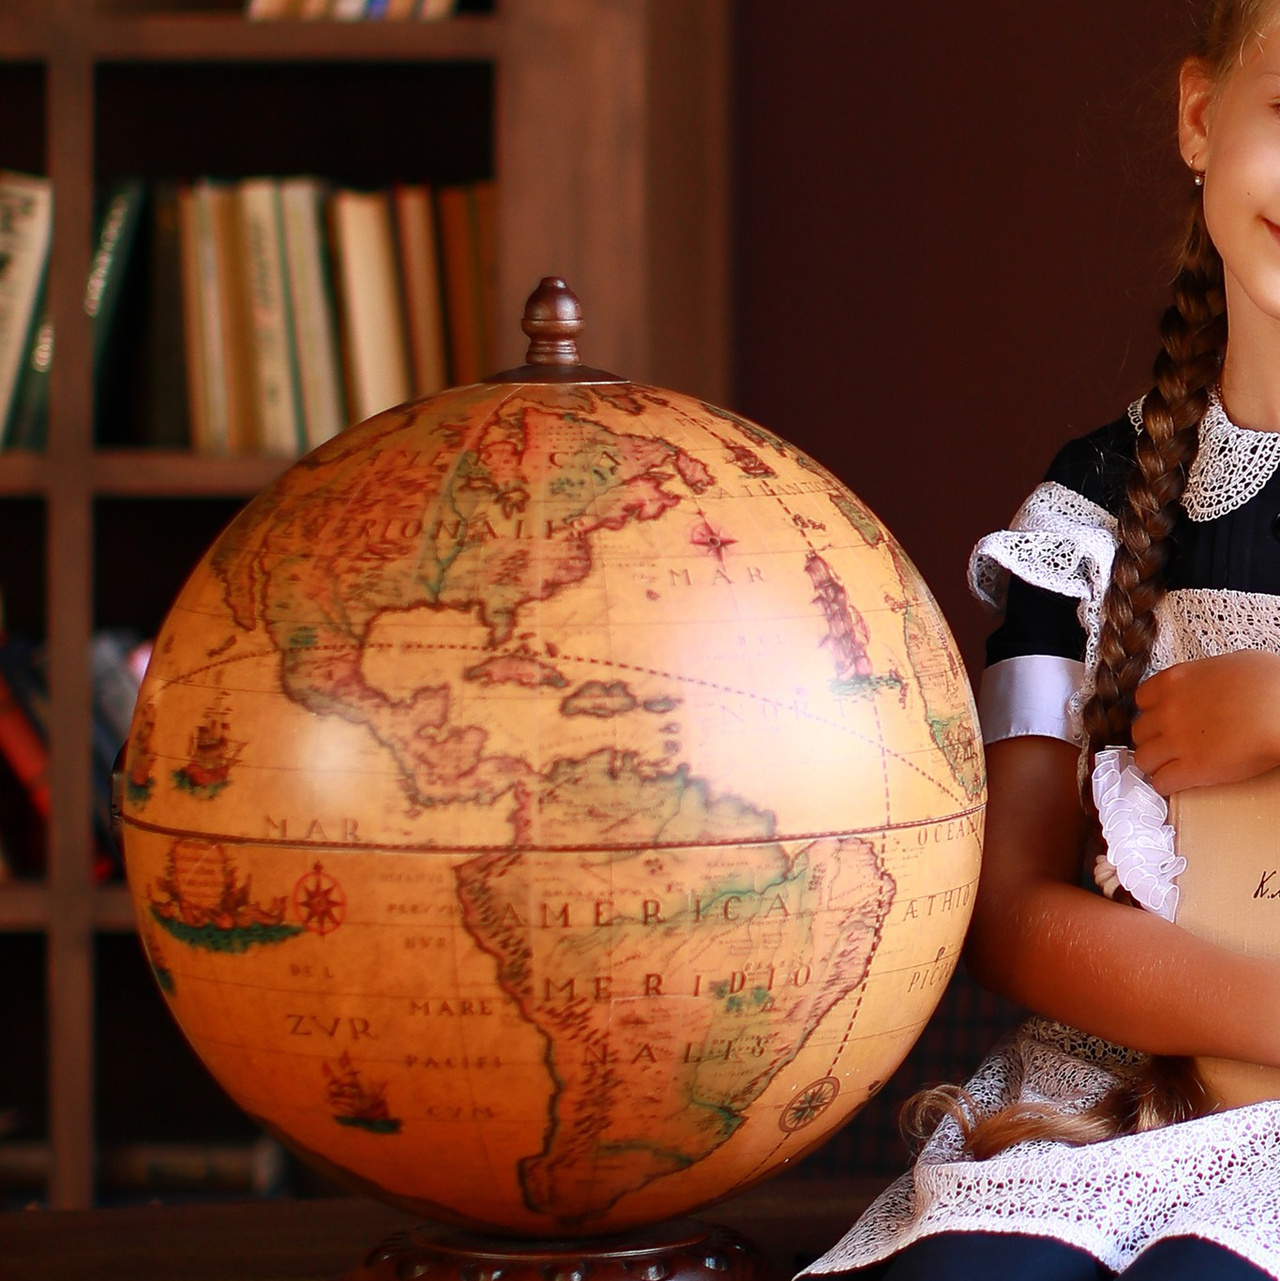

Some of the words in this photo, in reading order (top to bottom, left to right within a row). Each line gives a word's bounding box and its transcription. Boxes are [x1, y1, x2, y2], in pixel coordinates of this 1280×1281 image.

[668, 566, 766, 587] MAR
[263, 815, 363, 842] MAR
[500, 892, 790, 930] AMERICA
[543, 963, 812, 998] MERIDIO
[408, 999, 493, 1017] MARE
[285, 1013, 380, 1040] ZVR
[580, 1037, 770, 1066] NALIS
